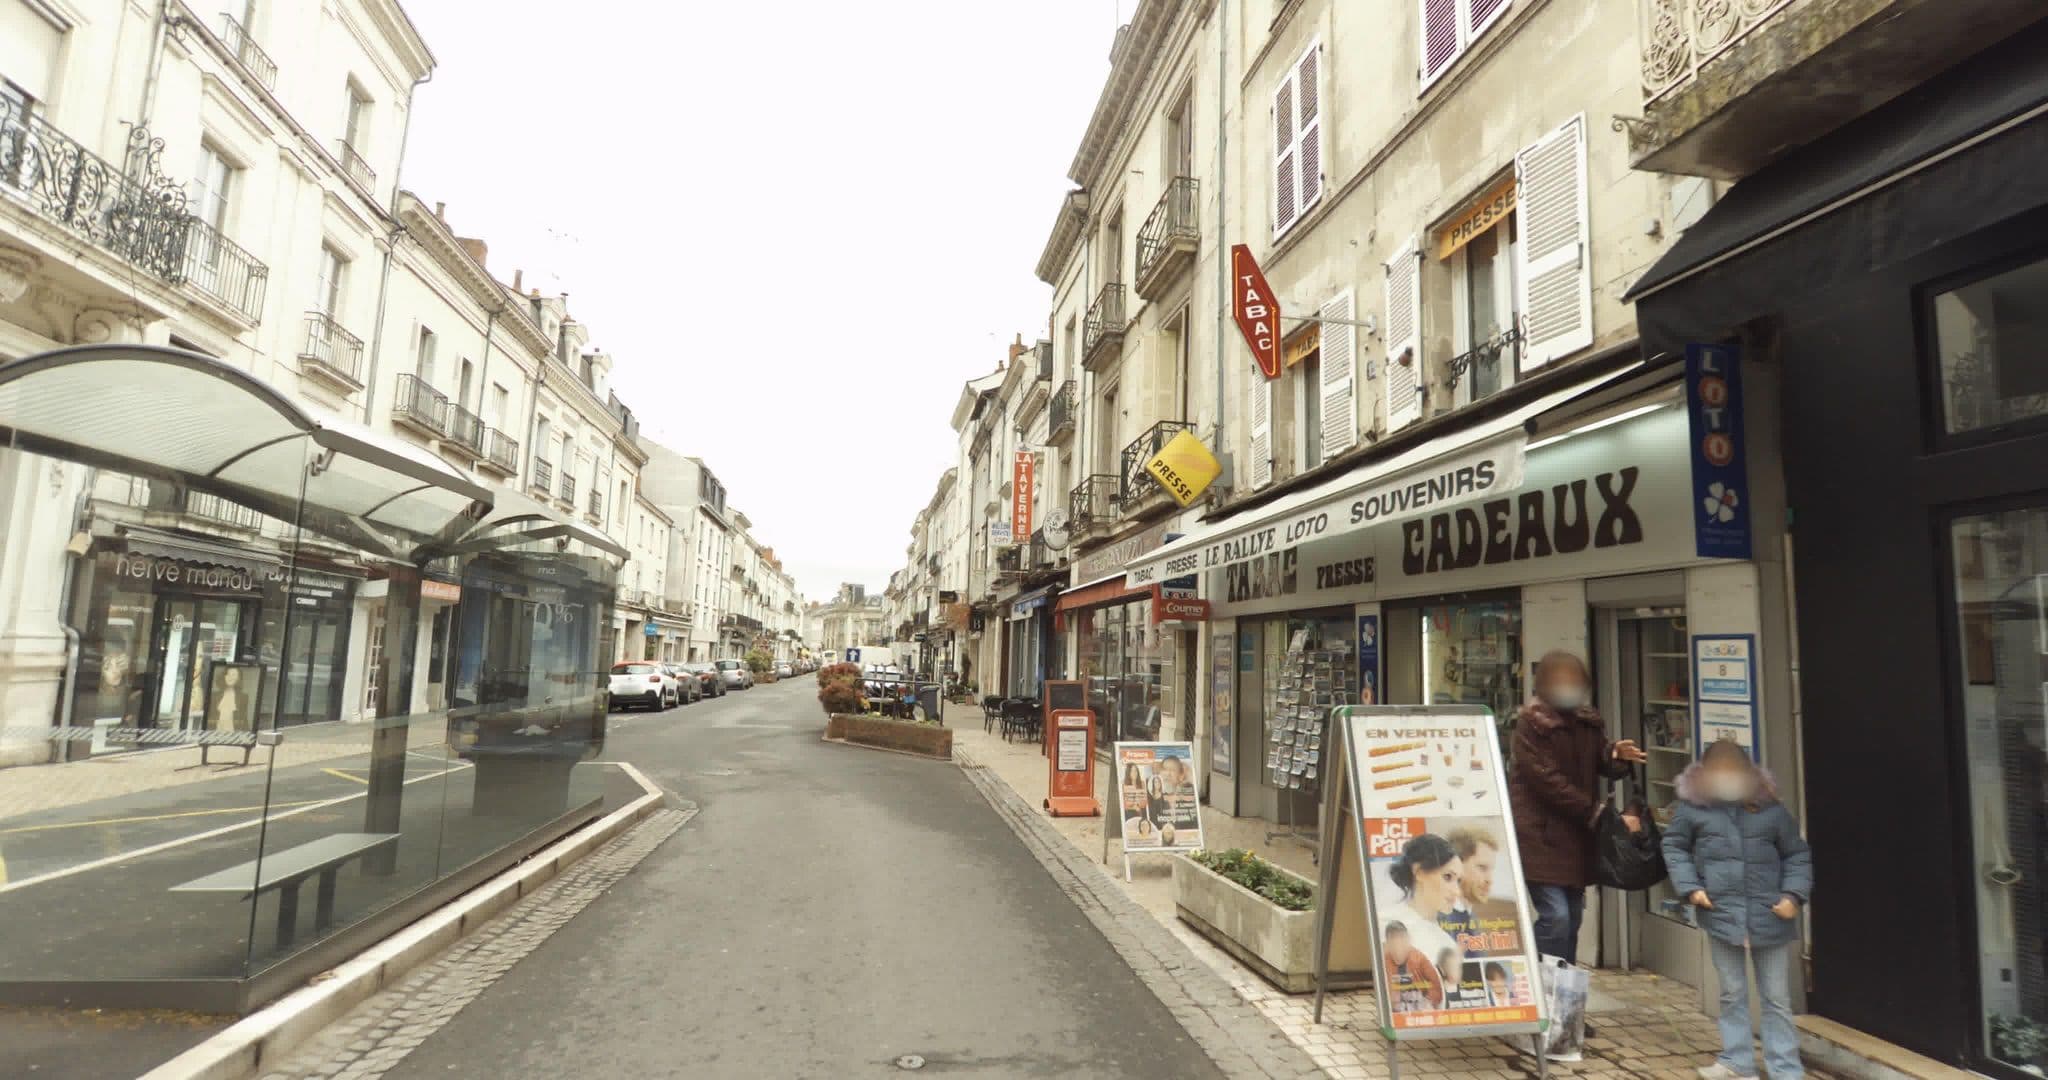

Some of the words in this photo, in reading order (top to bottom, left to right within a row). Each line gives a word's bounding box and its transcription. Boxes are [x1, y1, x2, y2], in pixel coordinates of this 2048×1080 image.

[1452, 187, 1516, 246] PRESSE
[1241, 275, 1272, 350] TABAC
[1701, 350, 1731, 462] LOTO
[1015, 453, 1032, 464] LA
[1153, 459, 1193, 501] PRESSE
[1017, 464, 1029, 535] TAVERNE
[1134, 566, 1154, 582] TABAC
[1166, 554, 1198, 575] PRESSE
[1205, 547, 1220, 568] LE
[1223, 527, 1276, 563] RALLYE
[1286, 512, 1328, 544] LOTO
[1350, 459, 1496, 525] SOUVENIRS
[1317, 556, 1374, 590] PRESSE
[1402, 465, 1643, 576] CADEAUX
[1365, 728, 1389, 739] EN
[1393, 728, 1450, 739] VENTE
[1453, 727, 1477, 738] ICI
[1370, 834, 1410, 856] Par
[1382, 818, 1412, 839] ici
